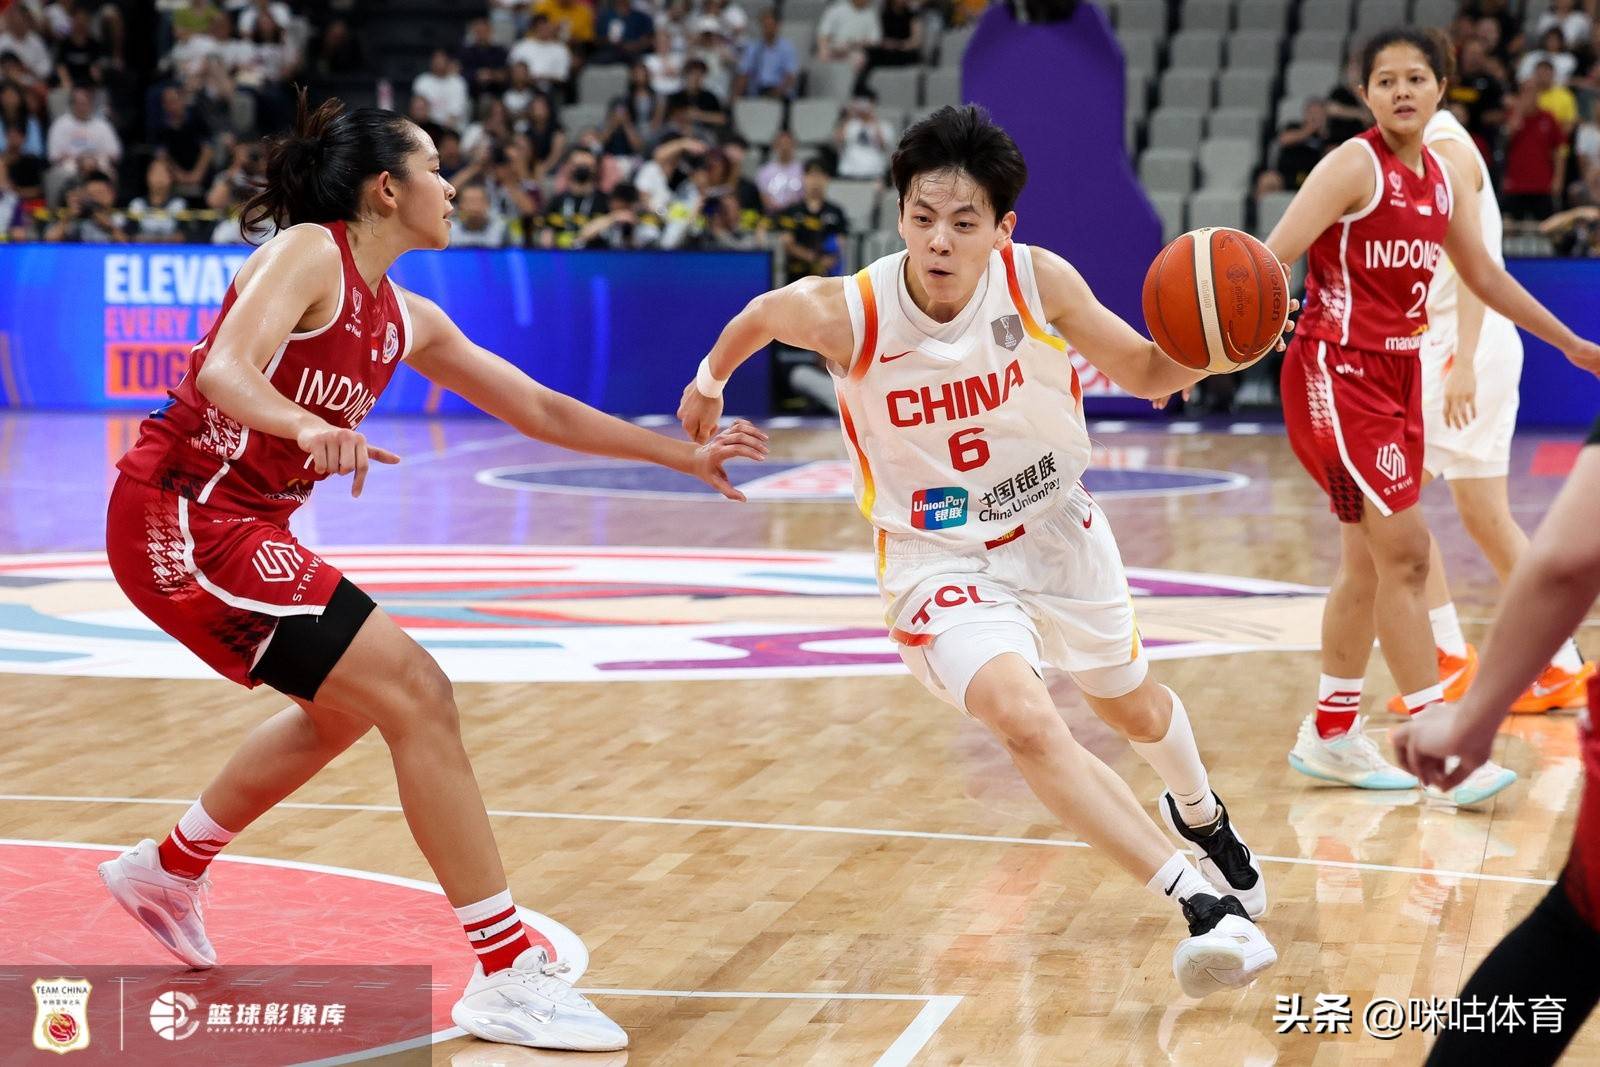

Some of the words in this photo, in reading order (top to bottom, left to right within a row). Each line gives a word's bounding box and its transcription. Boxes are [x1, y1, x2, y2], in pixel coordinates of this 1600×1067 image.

[1406, 281, 1427, 319] 2
[105, 306, 190, 338] EVERY
[886, 359, 1025, 428] CHINA
[948, 427, 991, 473] 6
[978, 451, 1058, 508] 中国银联
[979, 503, 1012, 522] China
[1013, 478, 1061, 513] UnionPay
[913, 495, 966, 513] UnionPay
[934, 507, 963, 522] 银联
[293, 556, 322, 602] STRIVE
[911, 585, 997, 626] TCL
